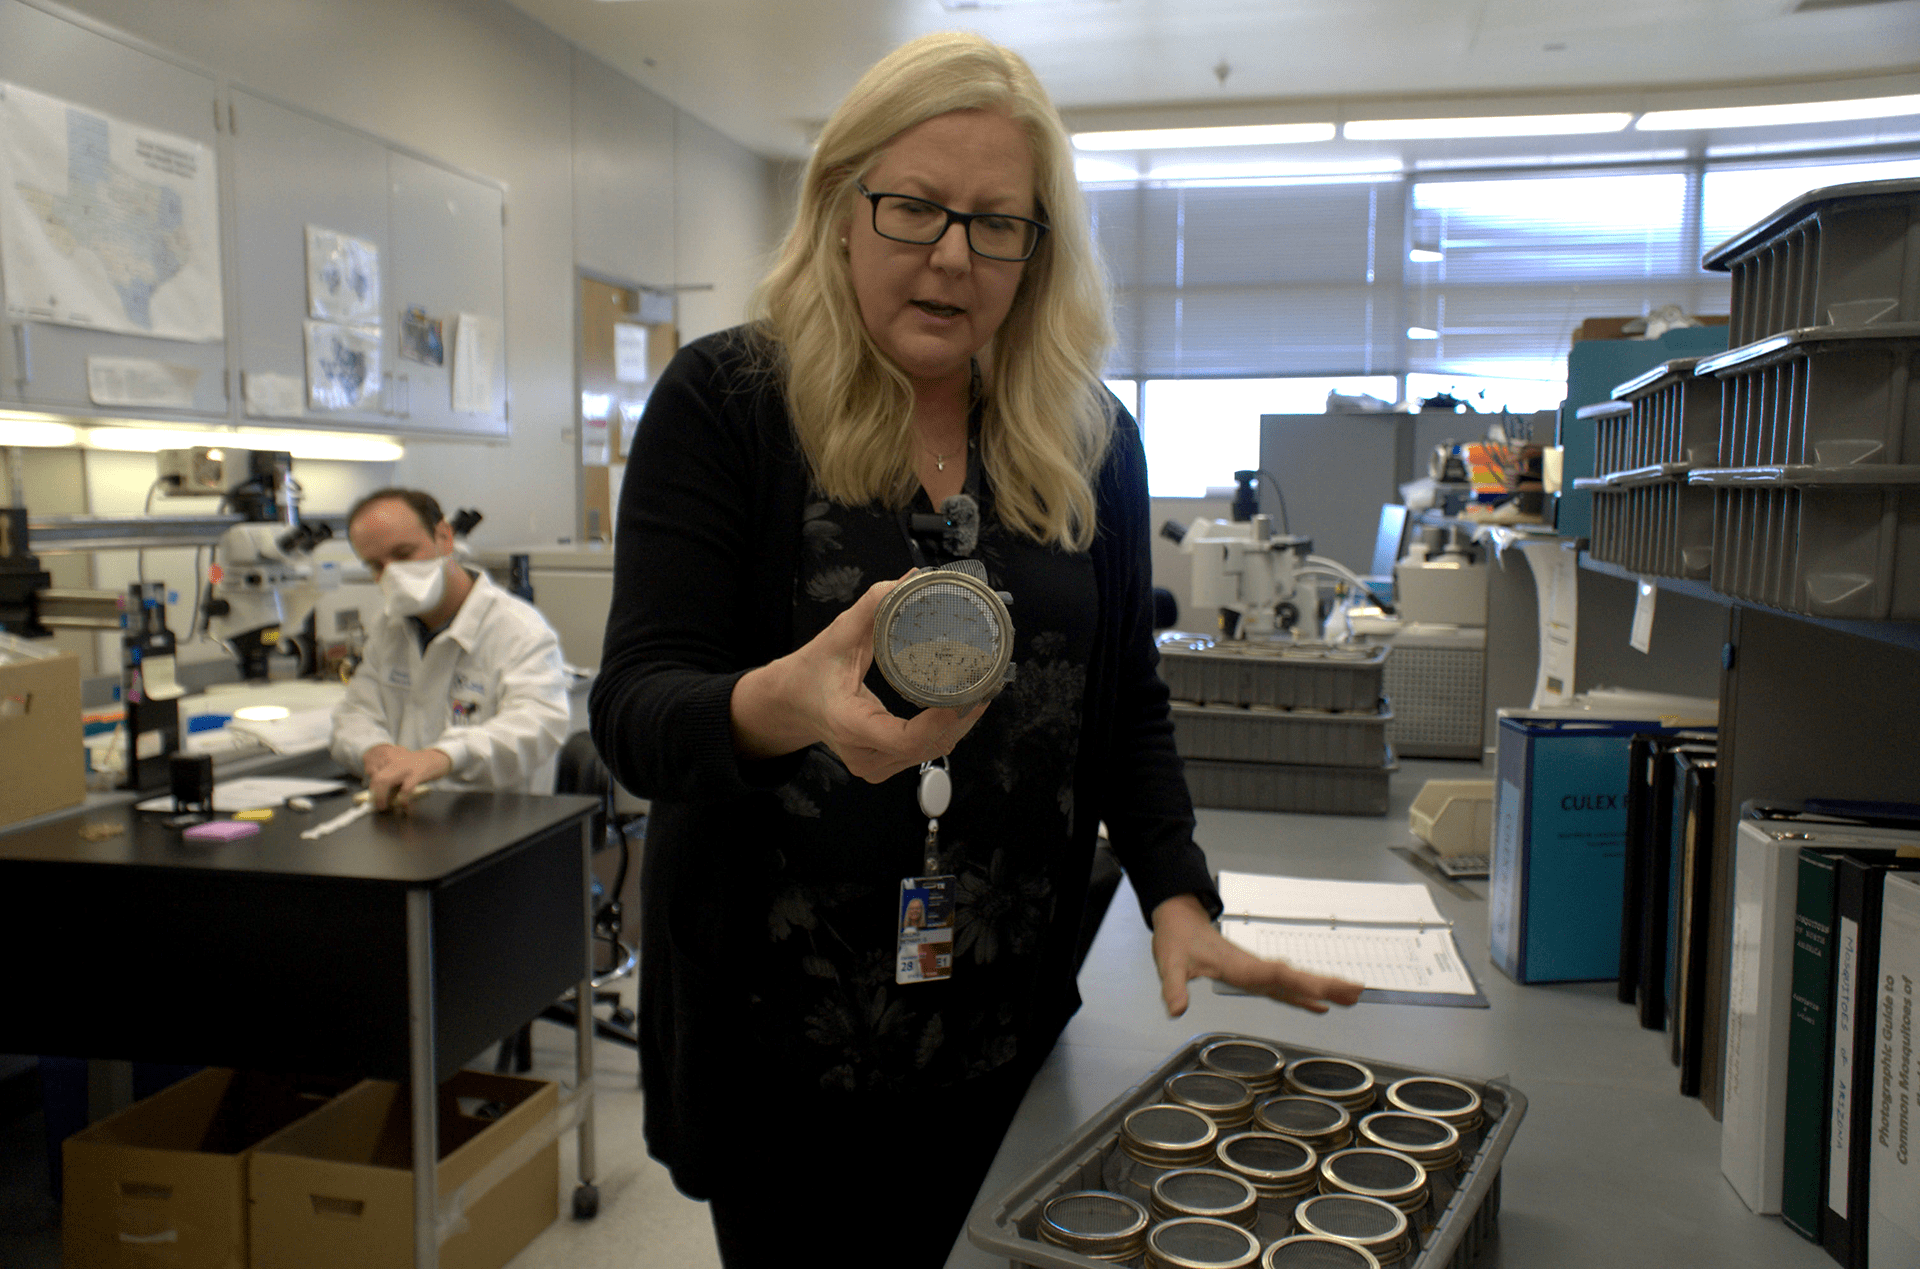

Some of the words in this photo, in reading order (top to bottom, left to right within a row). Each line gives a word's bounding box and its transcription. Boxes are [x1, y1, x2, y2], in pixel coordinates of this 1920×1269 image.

[1561, 795, 1617, 811] CULEX
[1884, 974, 1895, 992] to
[1902, 974, 1912, 995] of
[1882, 995, 1893, 1041] Guide
[1899, 997, 1912, 1091] Mosquitoes
[1836, 1080, 1846, 1149] ARIZONA
[1878, 1043, 1893, 1147] Photographic
[1896, 1093, 1909, 1165] Common
